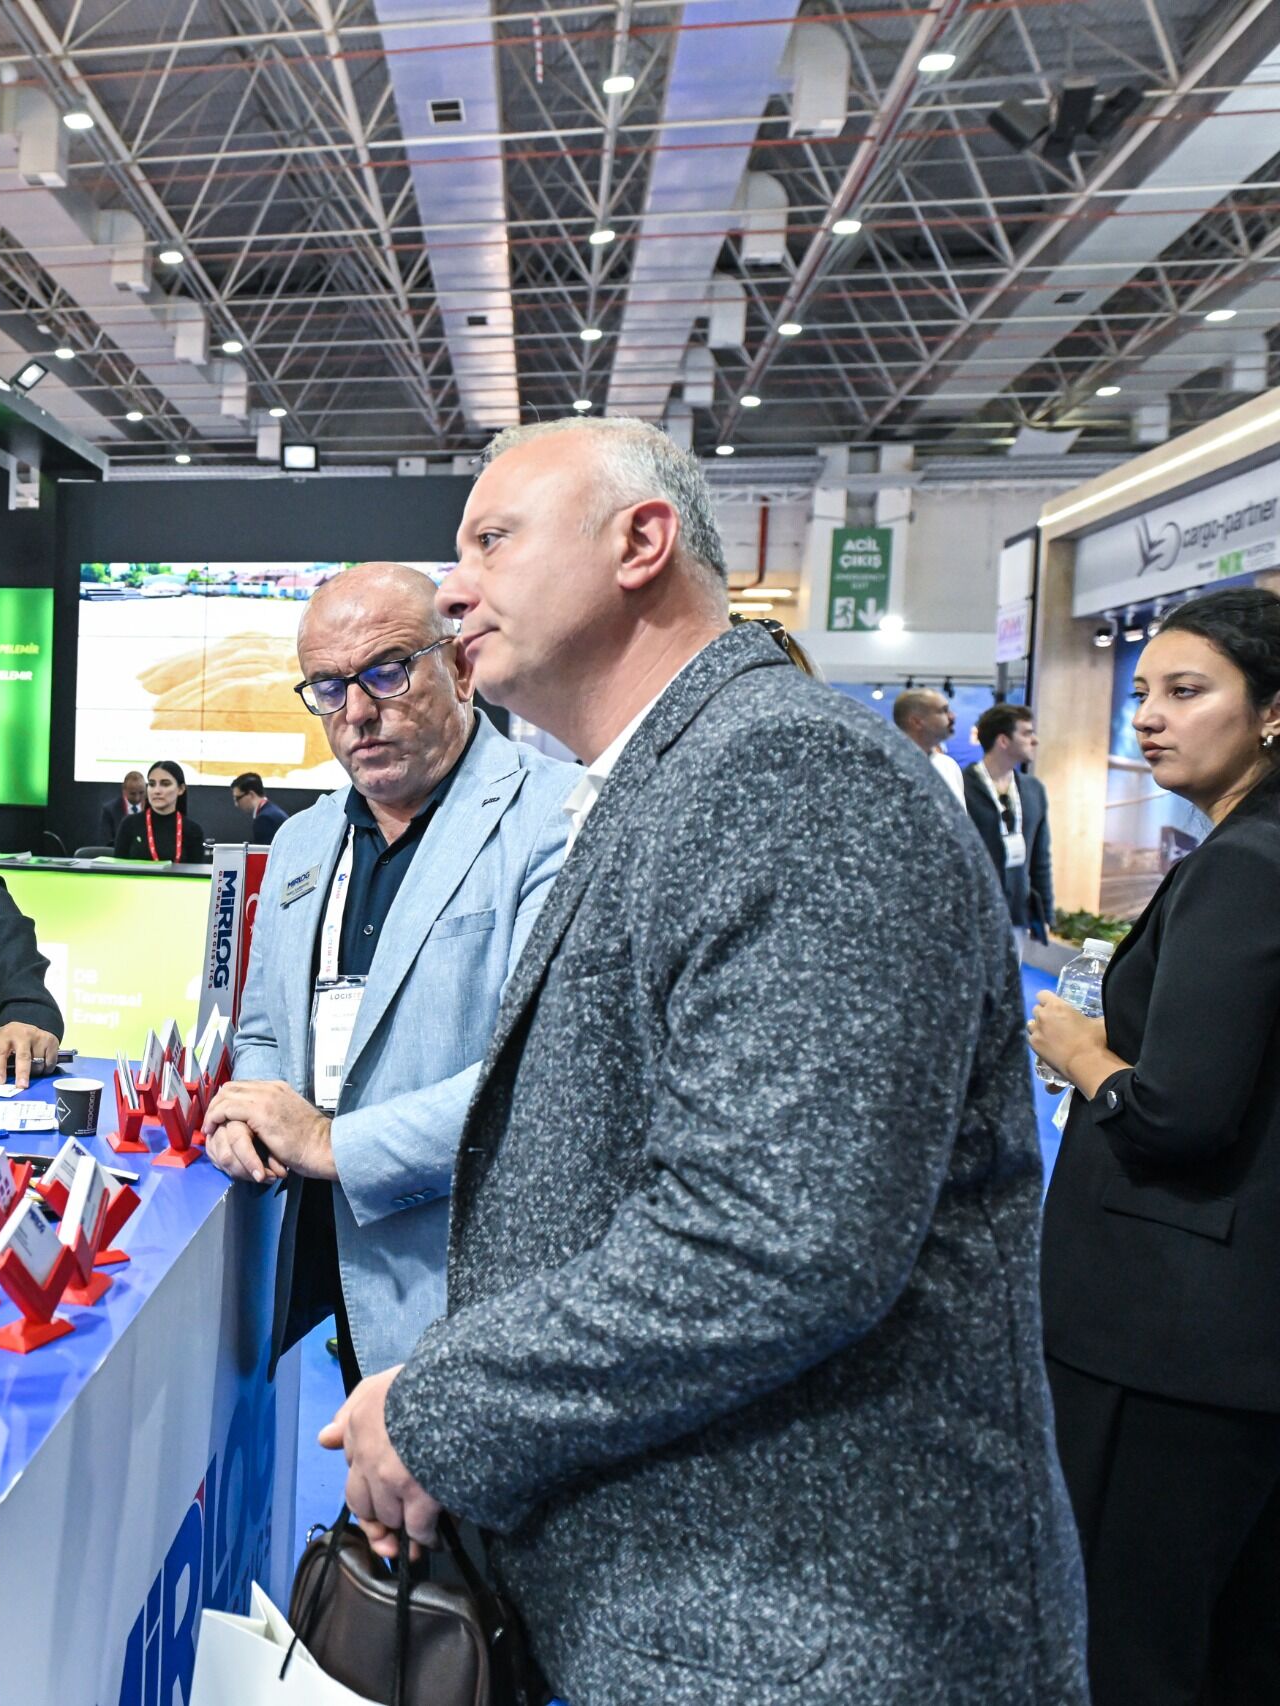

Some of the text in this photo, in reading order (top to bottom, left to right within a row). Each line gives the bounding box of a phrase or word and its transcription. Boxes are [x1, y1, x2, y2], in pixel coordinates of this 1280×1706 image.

[1182, 498, 1278, 549] cargo-partner
[207, 870, 224, 989] GLOBAL LOGISTICS
